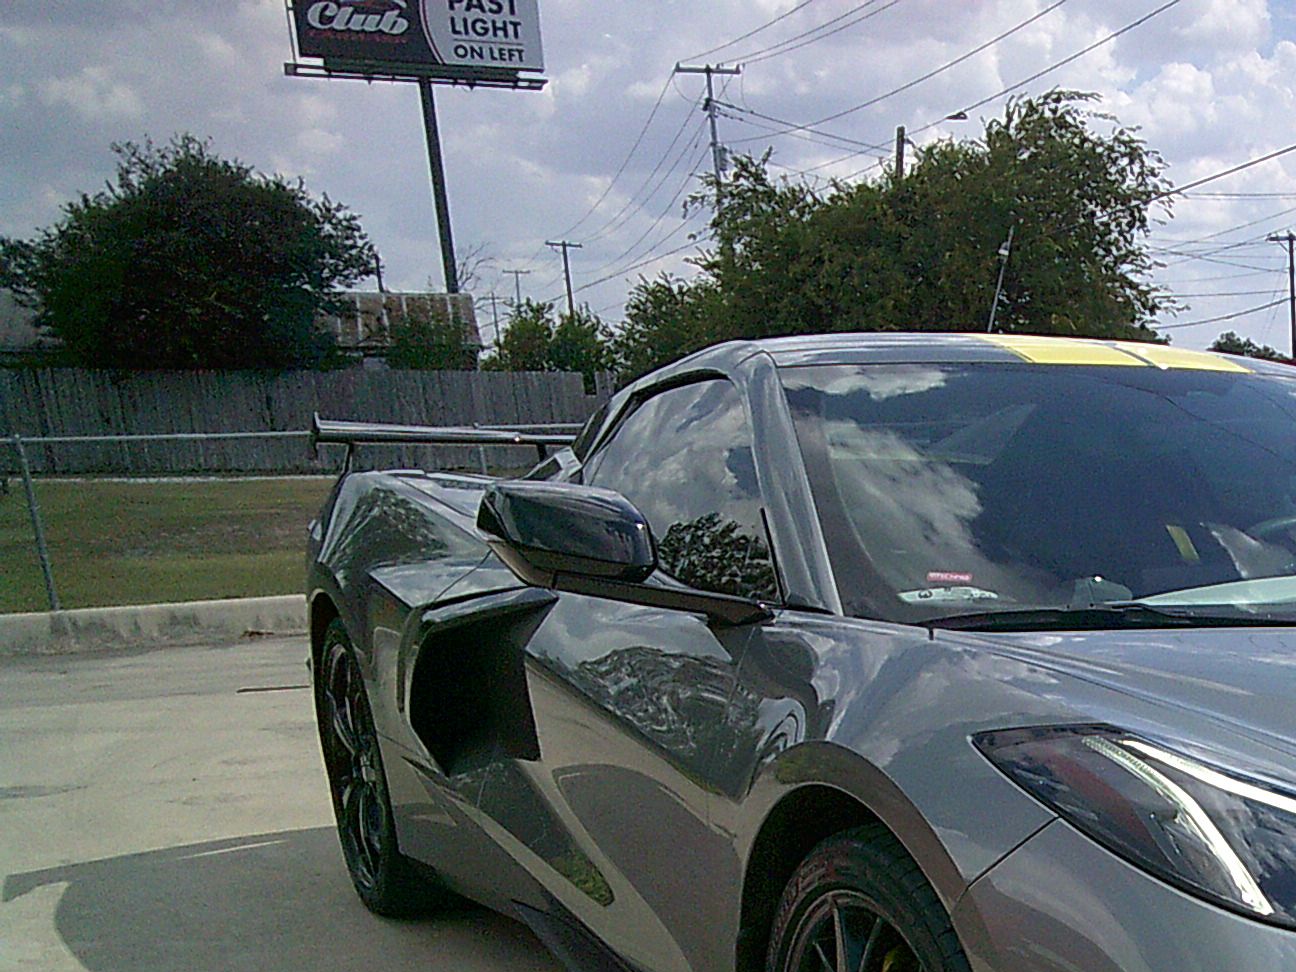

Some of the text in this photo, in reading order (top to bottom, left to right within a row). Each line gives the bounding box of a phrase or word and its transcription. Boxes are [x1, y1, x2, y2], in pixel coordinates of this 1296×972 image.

[307, 1, 409, 35] Club
[450, 15, 522, 39] LIGHT
[453, 44, 524, 62] ON LEFT
